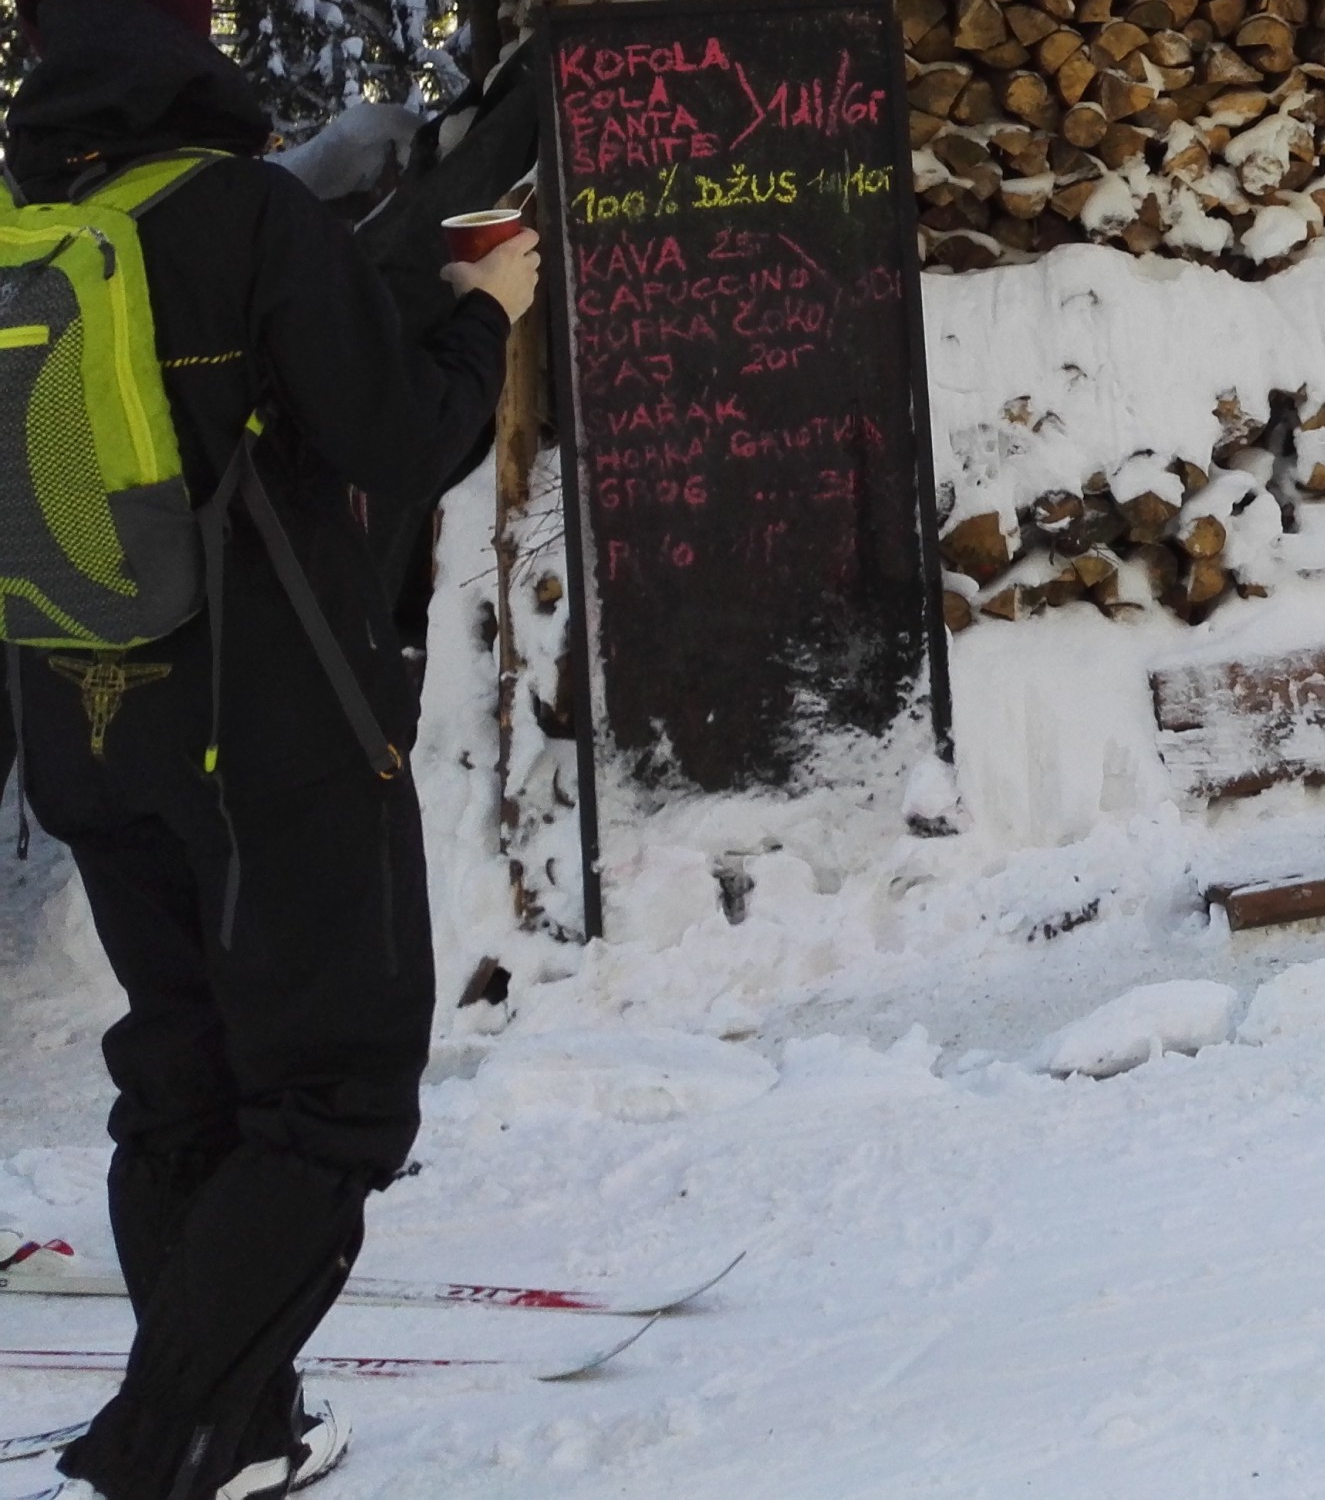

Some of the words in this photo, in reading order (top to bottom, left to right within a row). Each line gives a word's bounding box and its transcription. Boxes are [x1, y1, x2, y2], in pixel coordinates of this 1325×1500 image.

[559, 37, 731, 89] KOFOLA
[563, 75, 671, 119] COLA
[572, 133, 719, 175] SPRITE
[692, 163, 798, 209] DŽUS
